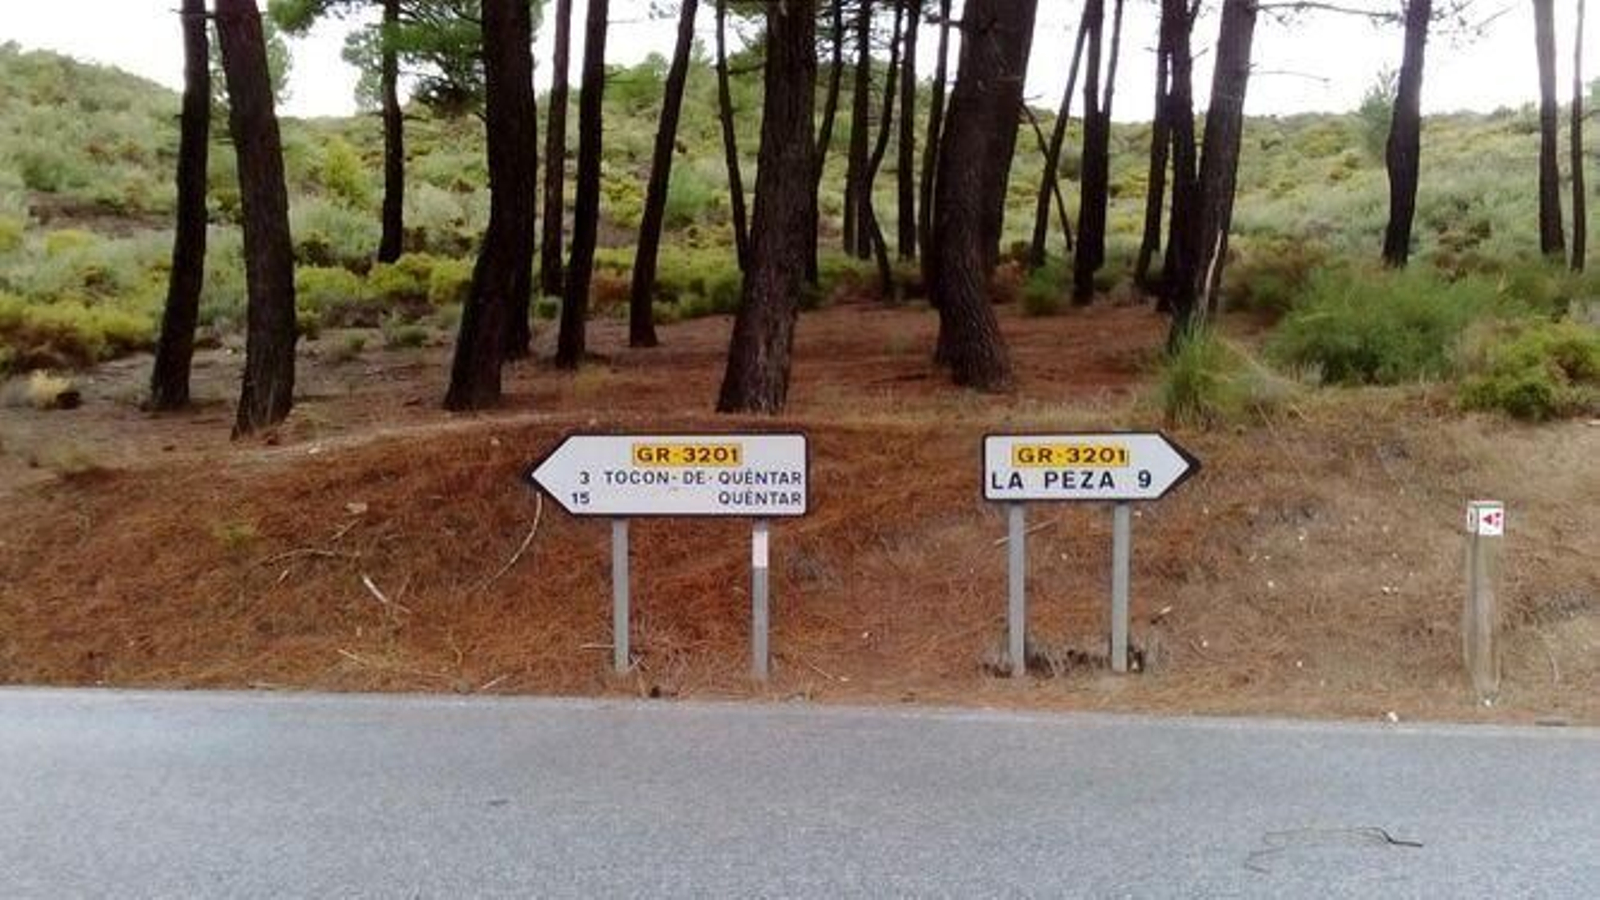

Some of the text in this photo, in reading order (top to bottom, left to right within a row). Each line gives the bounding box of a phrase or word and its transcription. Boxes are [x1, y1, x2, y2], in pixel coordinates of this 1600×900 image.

[580, 471, 590, 485] 3
[992, 470, 1152, 490] LA PEZA 9
[571, 491, 590, 505] 15
